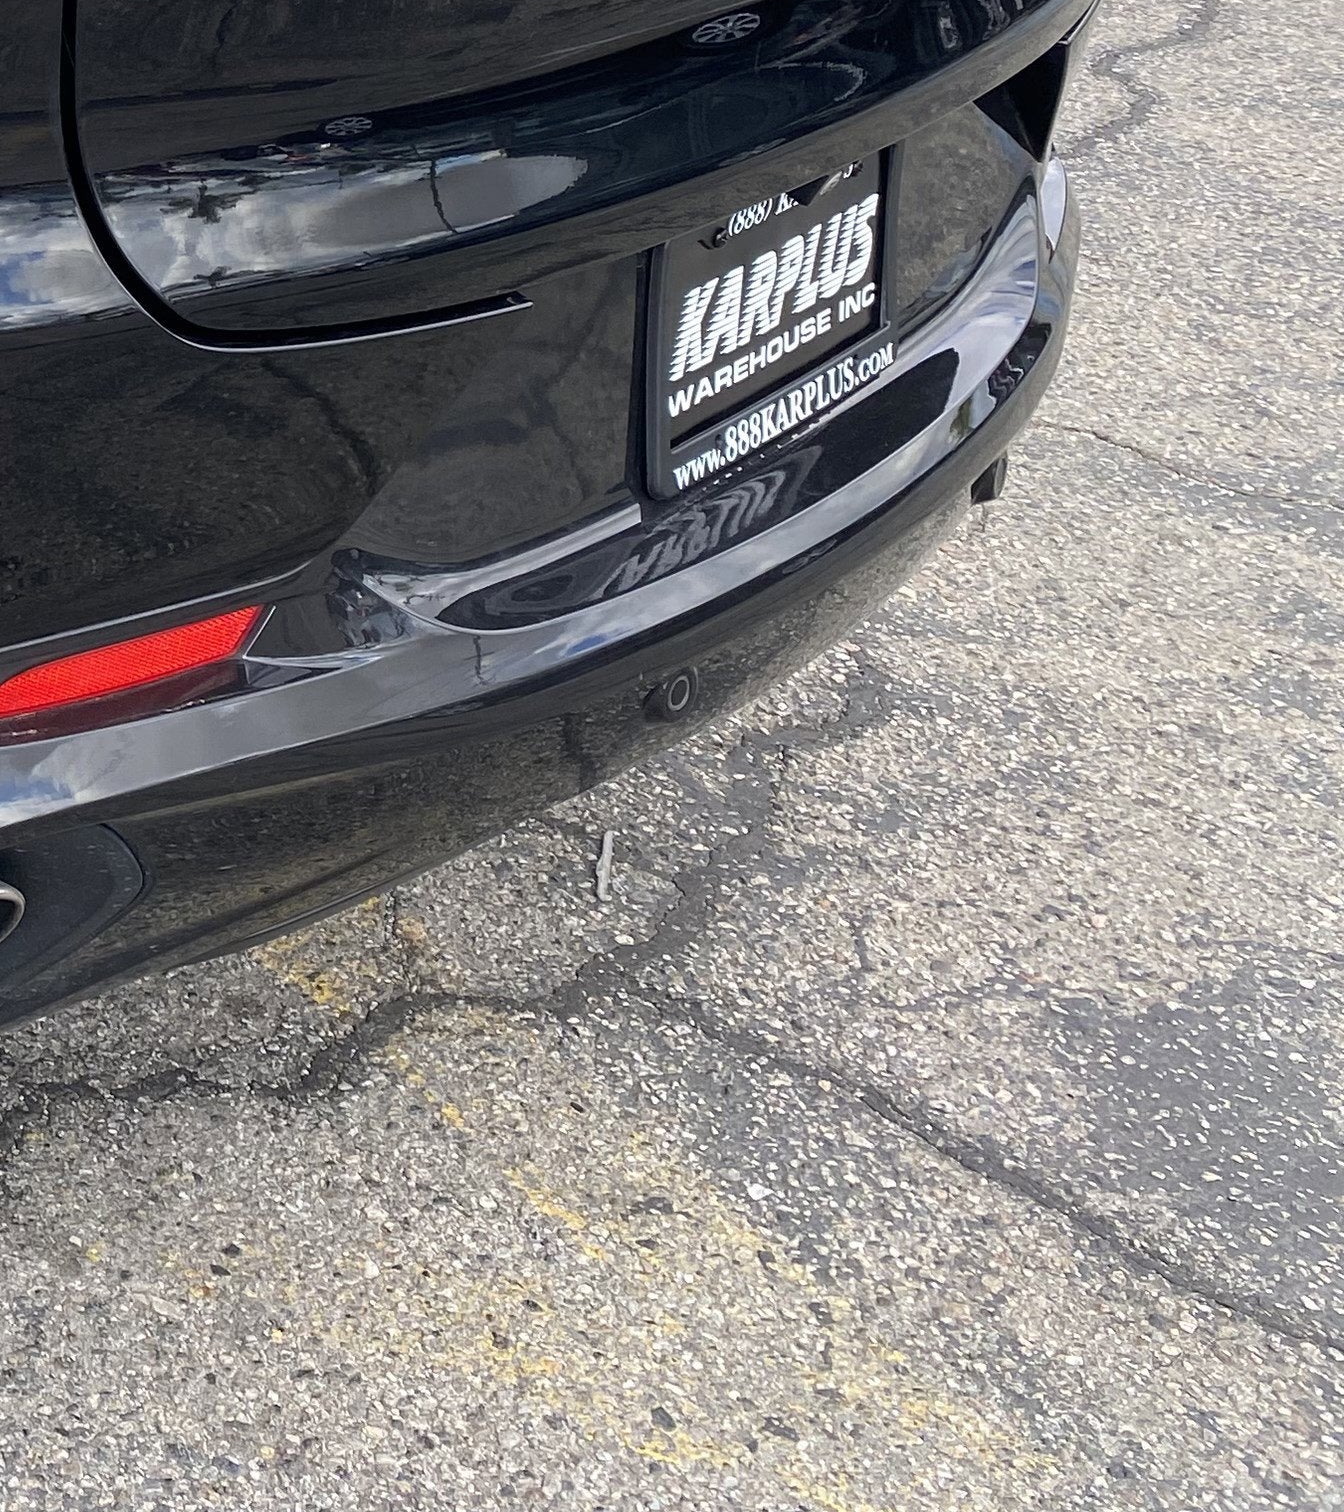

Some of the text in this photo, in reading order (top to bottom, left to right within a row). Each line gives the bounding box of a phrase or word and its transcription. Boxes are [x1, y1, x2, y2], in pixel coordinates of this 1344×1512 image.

[668, 282, 876, 417] WAREHOUSE INC
[669, 193, 880, 382] KARPLUS
